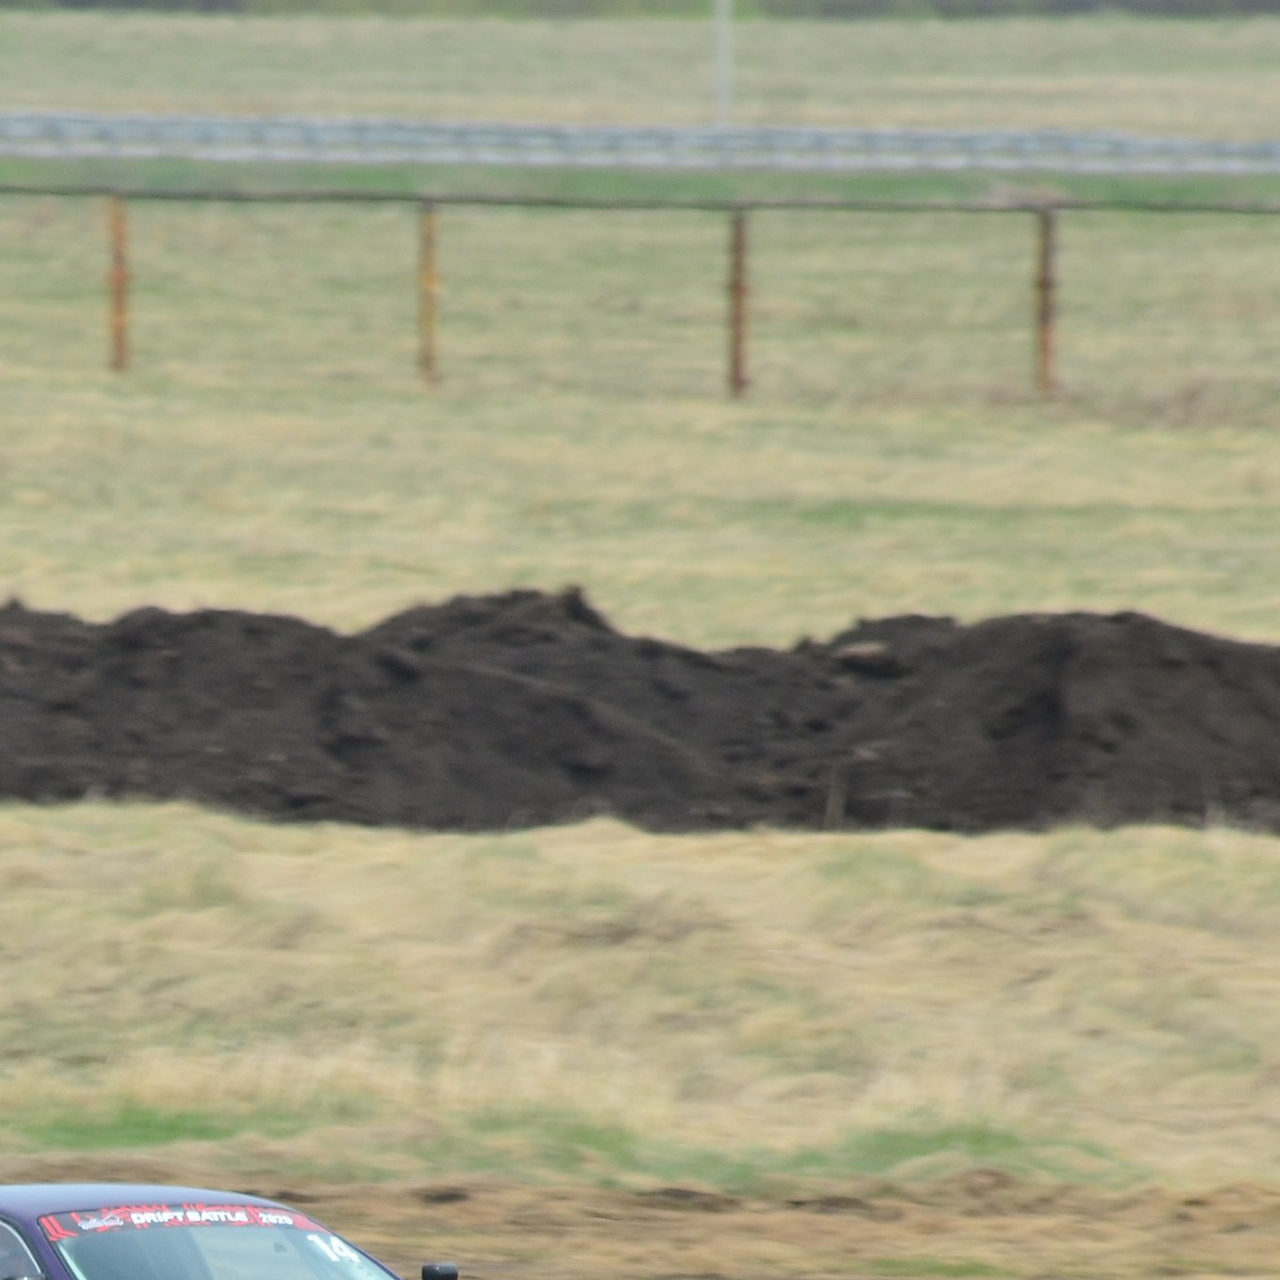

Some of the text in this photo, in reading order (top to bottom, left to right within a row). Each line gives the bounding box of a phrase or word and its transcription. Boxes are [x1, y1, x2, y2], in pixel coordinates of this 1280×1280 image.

[130, 1211, 184, 1225] DRIFT
[186, 1210, 248, 1223] BATTLE
[306, 1234, 360, 1263] 14
